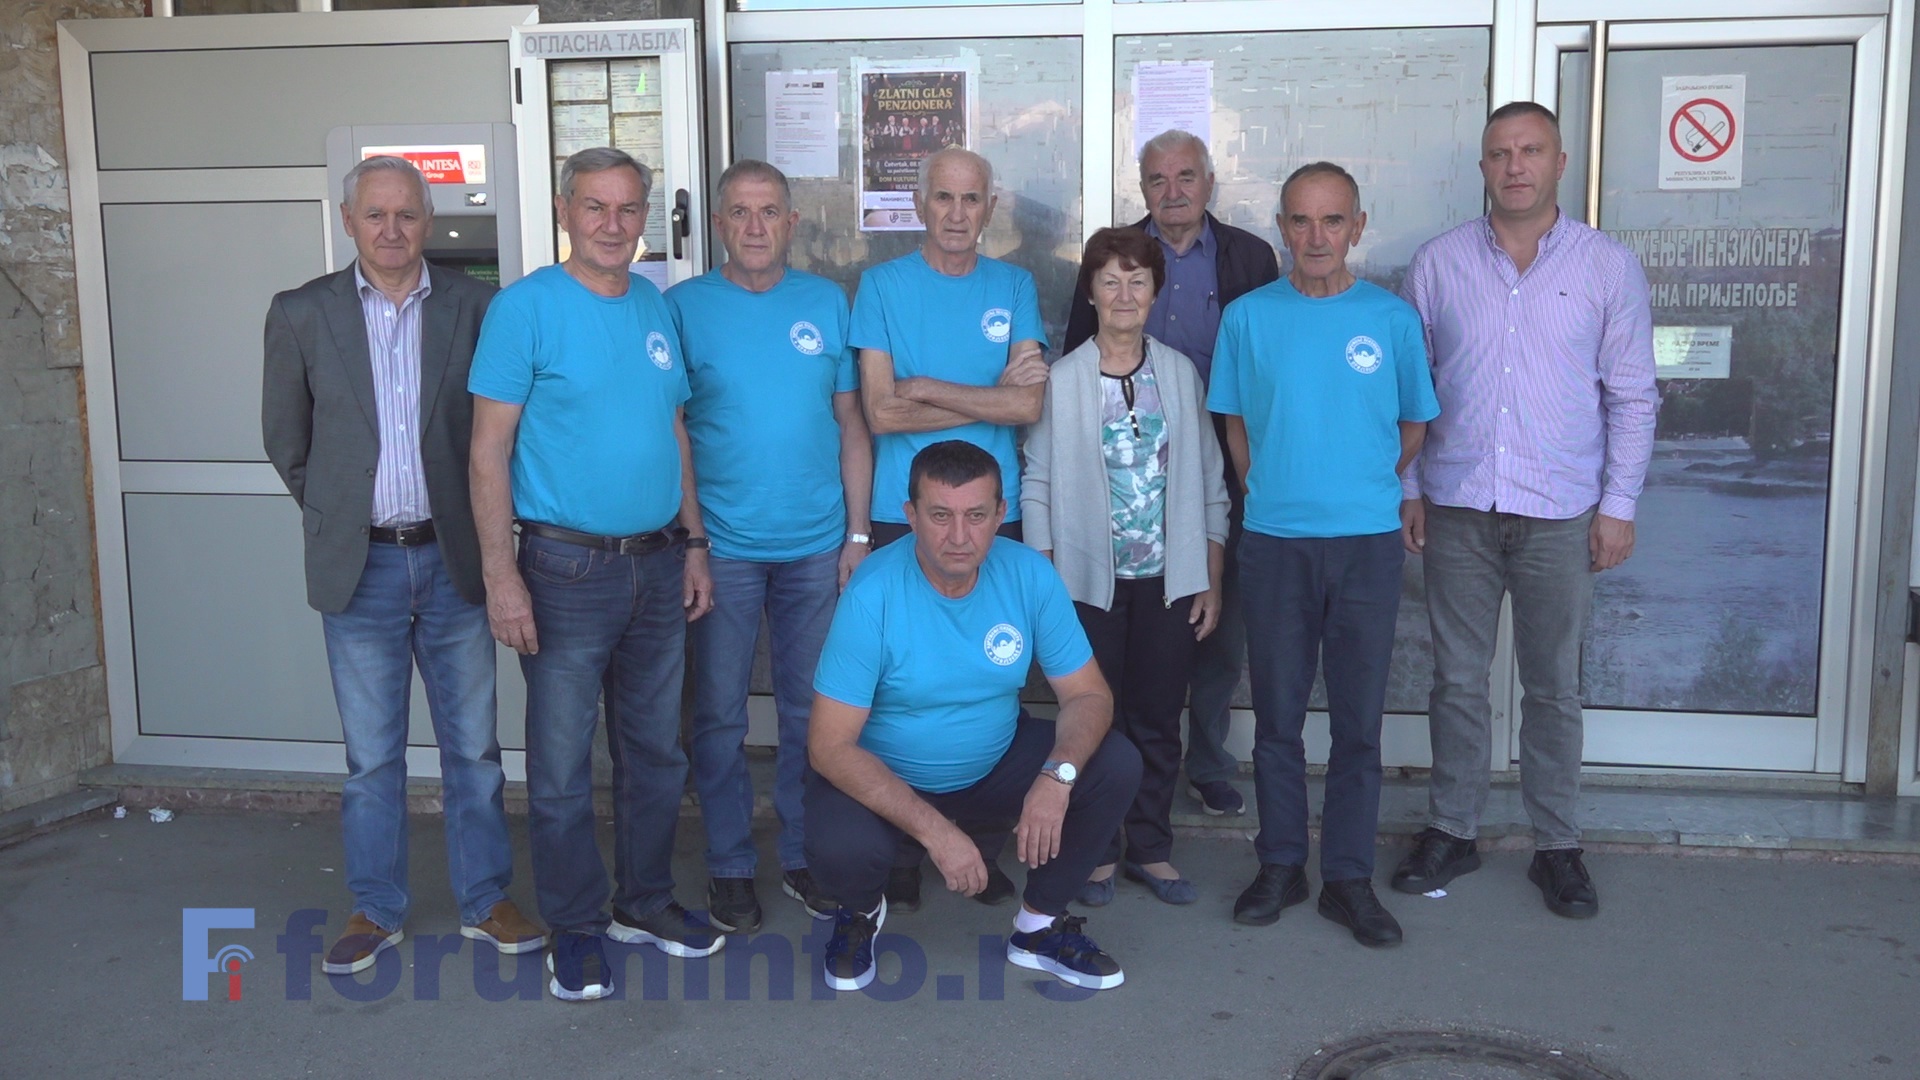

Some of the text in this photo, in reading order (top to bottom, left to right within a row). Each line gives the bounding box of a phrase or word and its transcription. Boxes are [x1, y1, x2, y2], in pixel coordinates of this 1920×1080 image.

[524, 31, 680, 54] ОГЛАСНА ТАБЛА
[878, 87, 953, 99] ZLATNI GLAS
[878, 100, 953, 110] PENZIONERA
[422, 159, 460, 170] INTESA
[1692, 228, 1811, 267] ПЕНЗИОНЕРА
[1685, 282, 1798, 307] ПРИЈЕПОЉЕ
